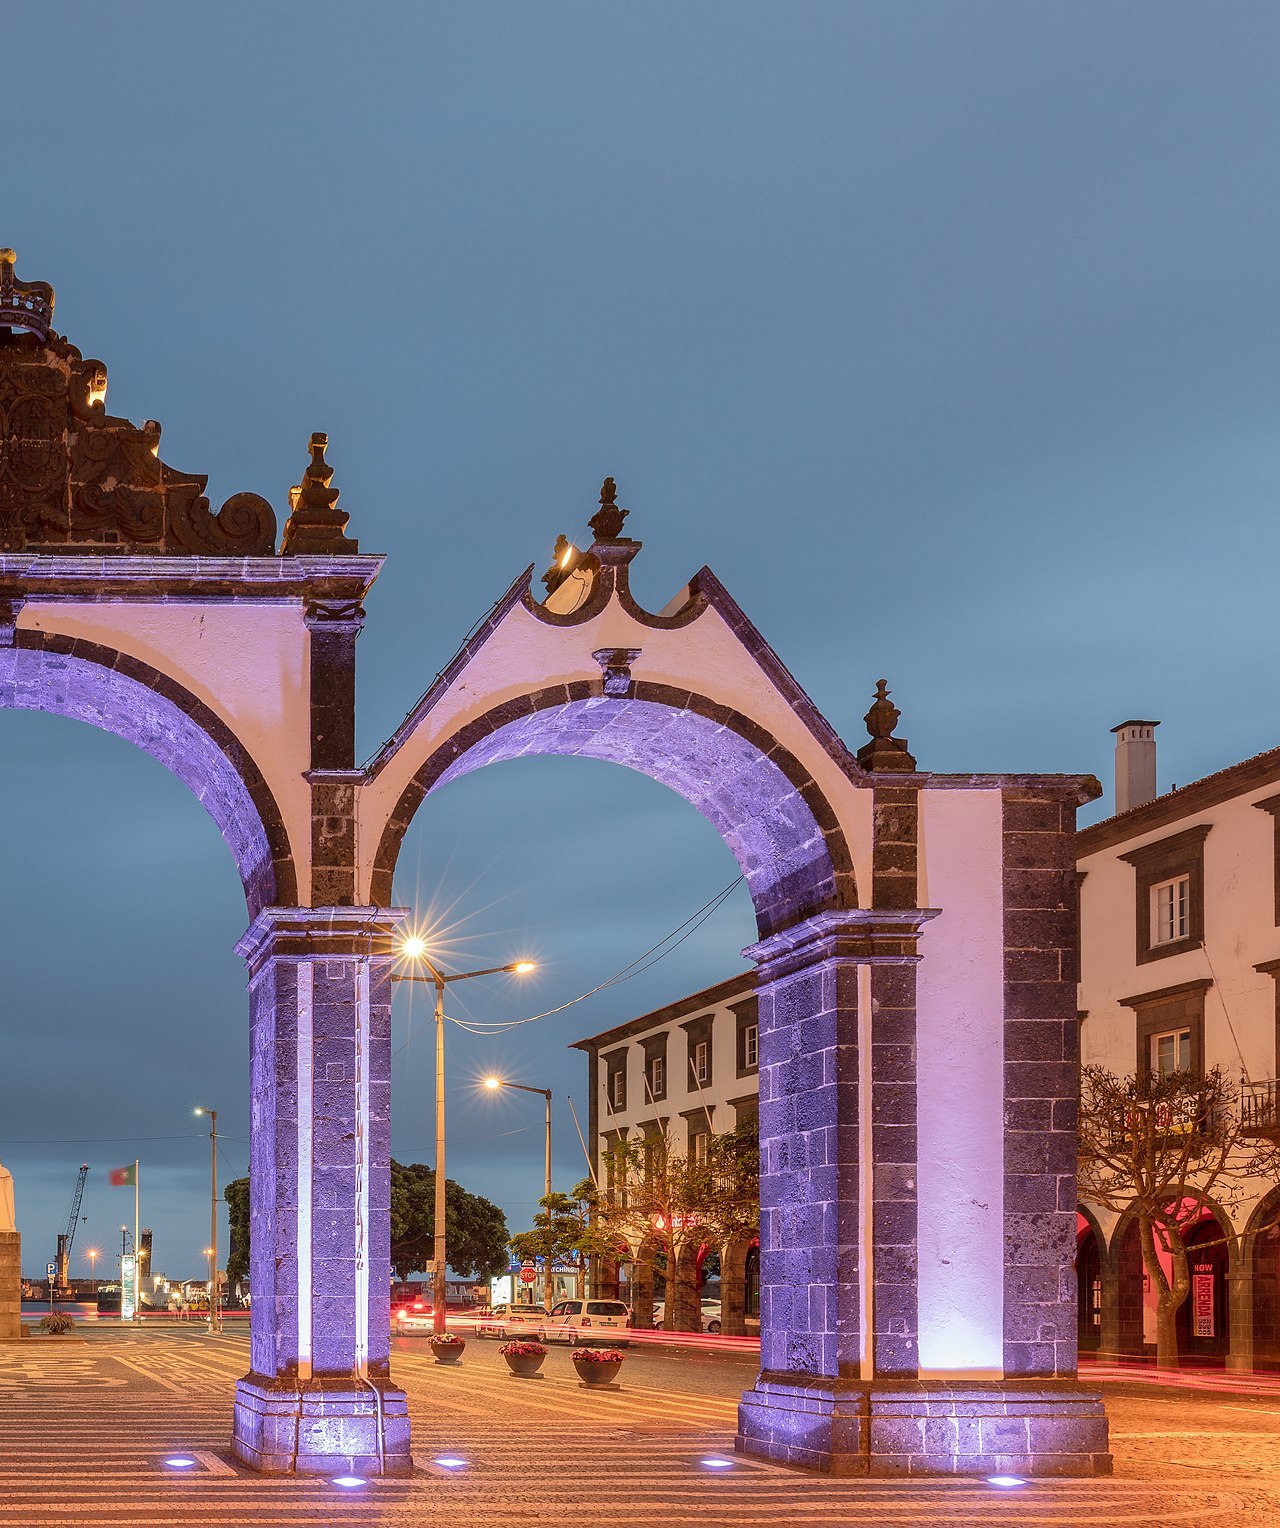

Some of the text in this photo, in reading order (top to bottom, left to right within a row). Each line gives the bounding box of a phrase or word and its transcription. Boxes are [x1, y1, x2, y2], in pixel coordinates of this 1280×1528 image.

[48, 1264, 55, 1273] P
[1194, 1264, 1213, 1272] NOW
[1198, 1276, 1211, 1317] ARRENDA
